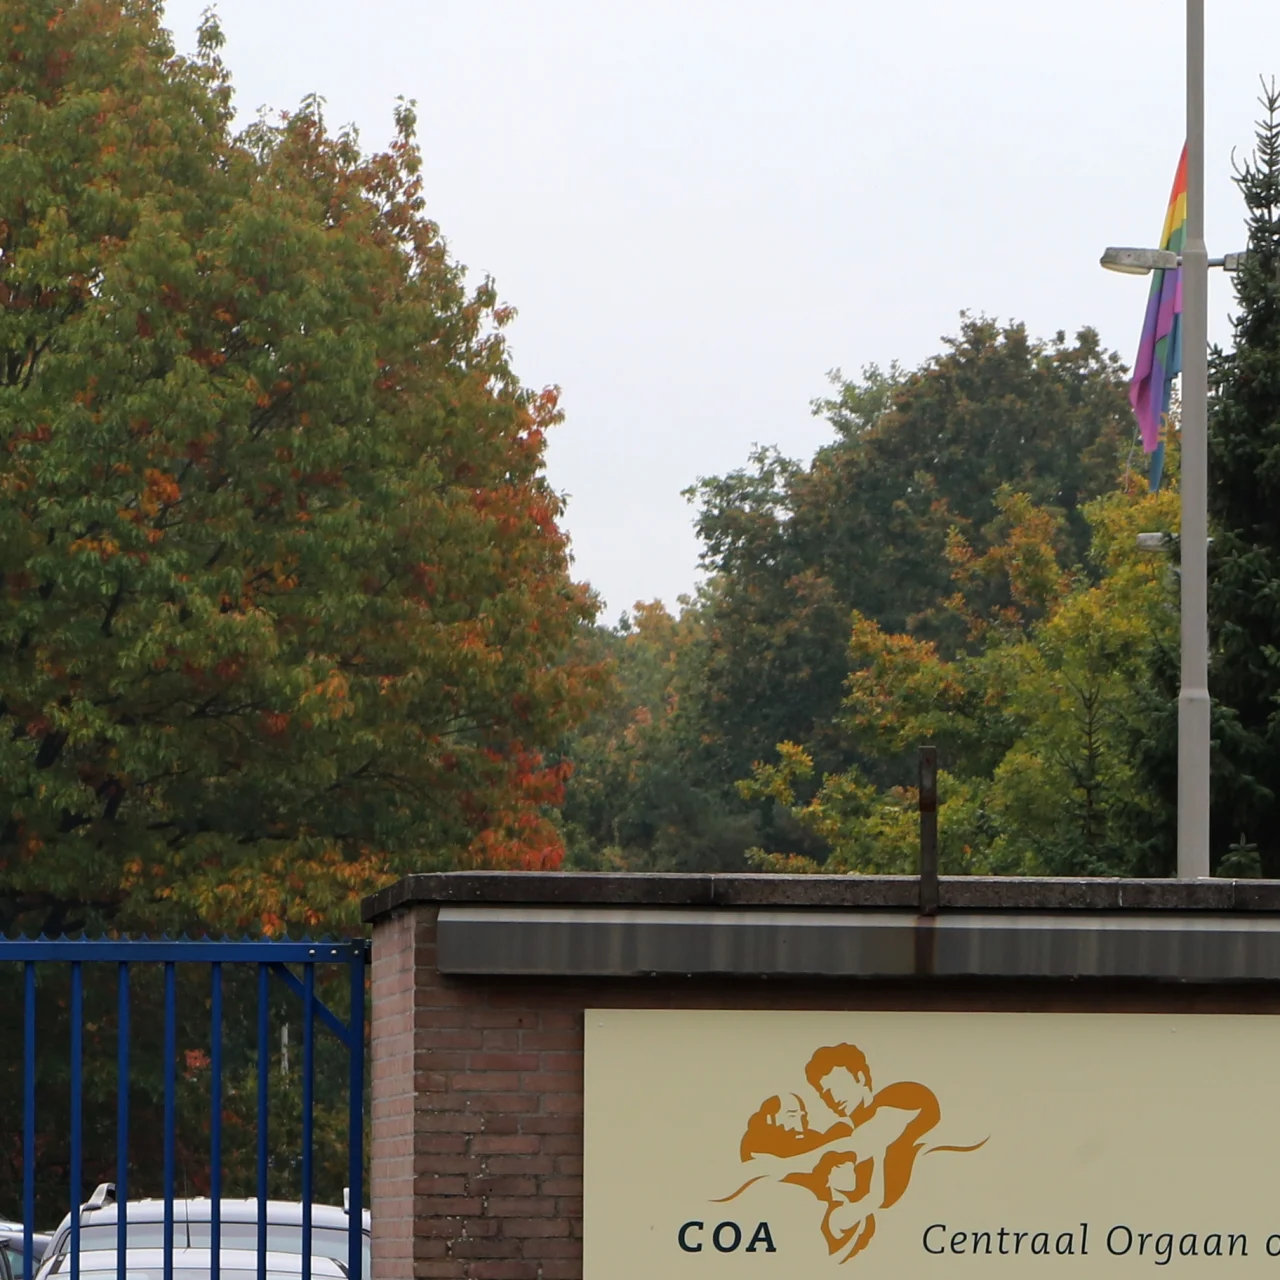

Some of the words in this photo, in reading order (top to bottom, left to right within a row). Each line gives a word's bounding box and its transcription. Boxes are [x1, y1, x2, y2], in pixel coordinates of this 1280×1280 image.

[677, 1220, 777, 1253] COA
[922, 1222, 1088, 1255] Centraal
[1106, 1224, 1248, 1266] Orgaan
